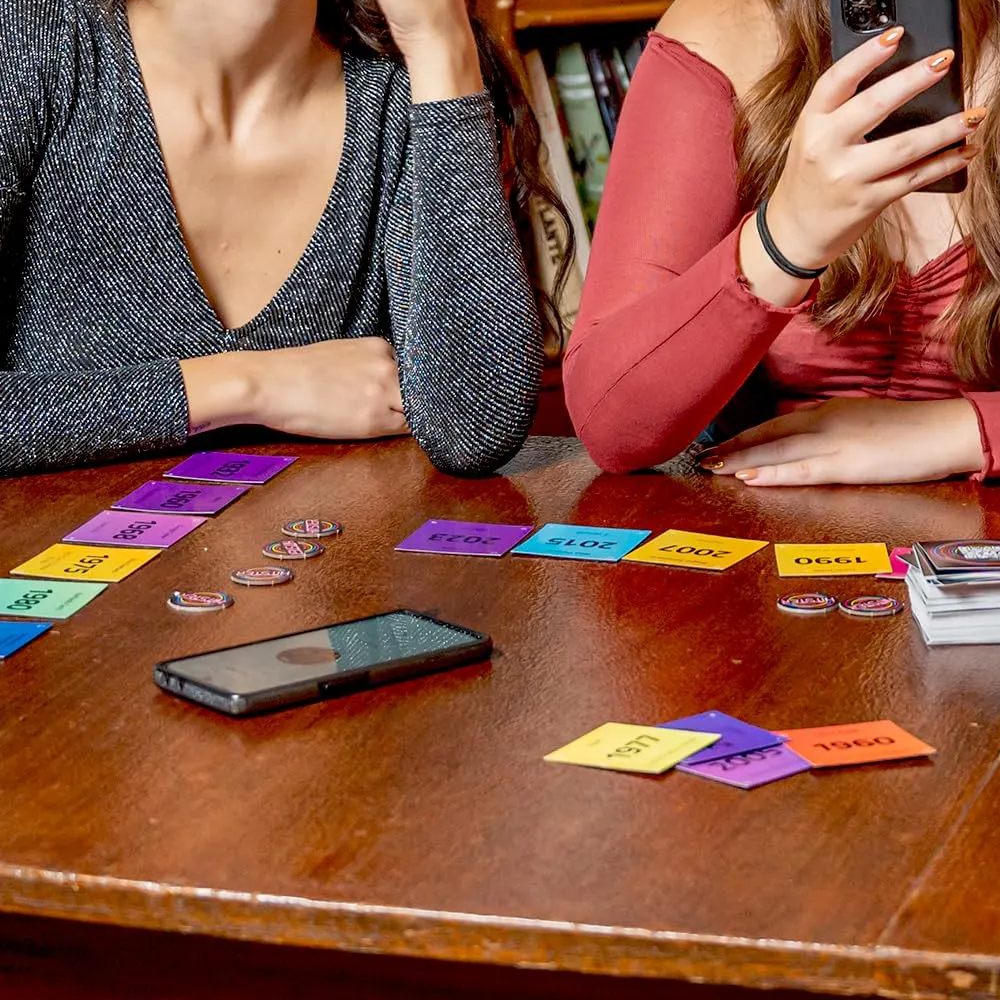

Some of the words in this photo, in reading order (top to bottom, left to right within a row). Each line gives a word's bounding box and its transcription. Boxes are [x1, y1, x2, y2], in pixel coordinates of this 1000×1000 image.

[112, 520, 158, 541] 1968
[428, 533, 502, 546] 2023
[547, 537, 619, 550] 2015
[659, 544, 732, 558] 2007
[64, 554, 109, 574] 1975
[794, 555, 868, 567] 1990
[7, 588, 53, 611] 1980
[607, 734, 661, 760] 1977
[813, 736, 896, 753] 1960
